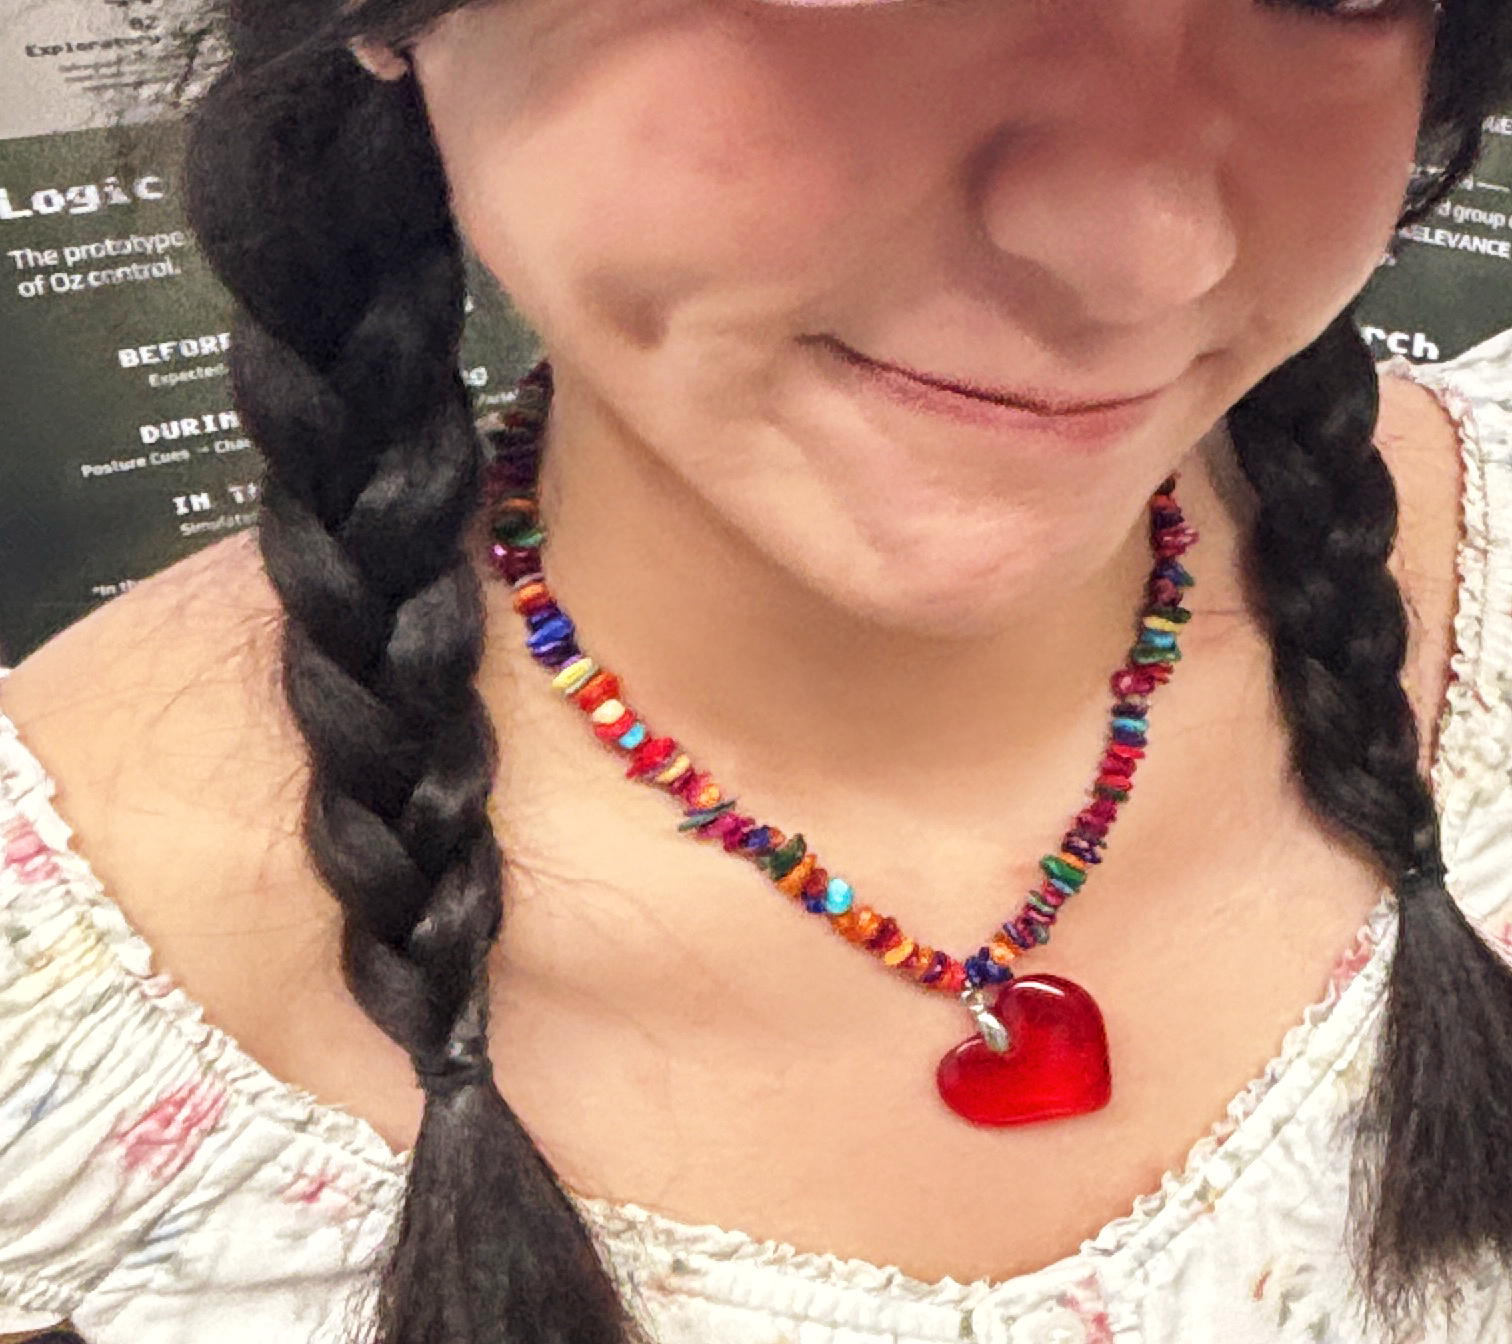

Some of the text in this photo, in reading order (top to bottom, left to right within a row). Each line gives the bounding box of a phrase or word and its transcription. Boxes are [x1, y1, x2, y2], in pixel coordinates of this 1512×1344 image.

[0, 176, 164, 219] Logic
[9, 231, 187, 269] The prototype
